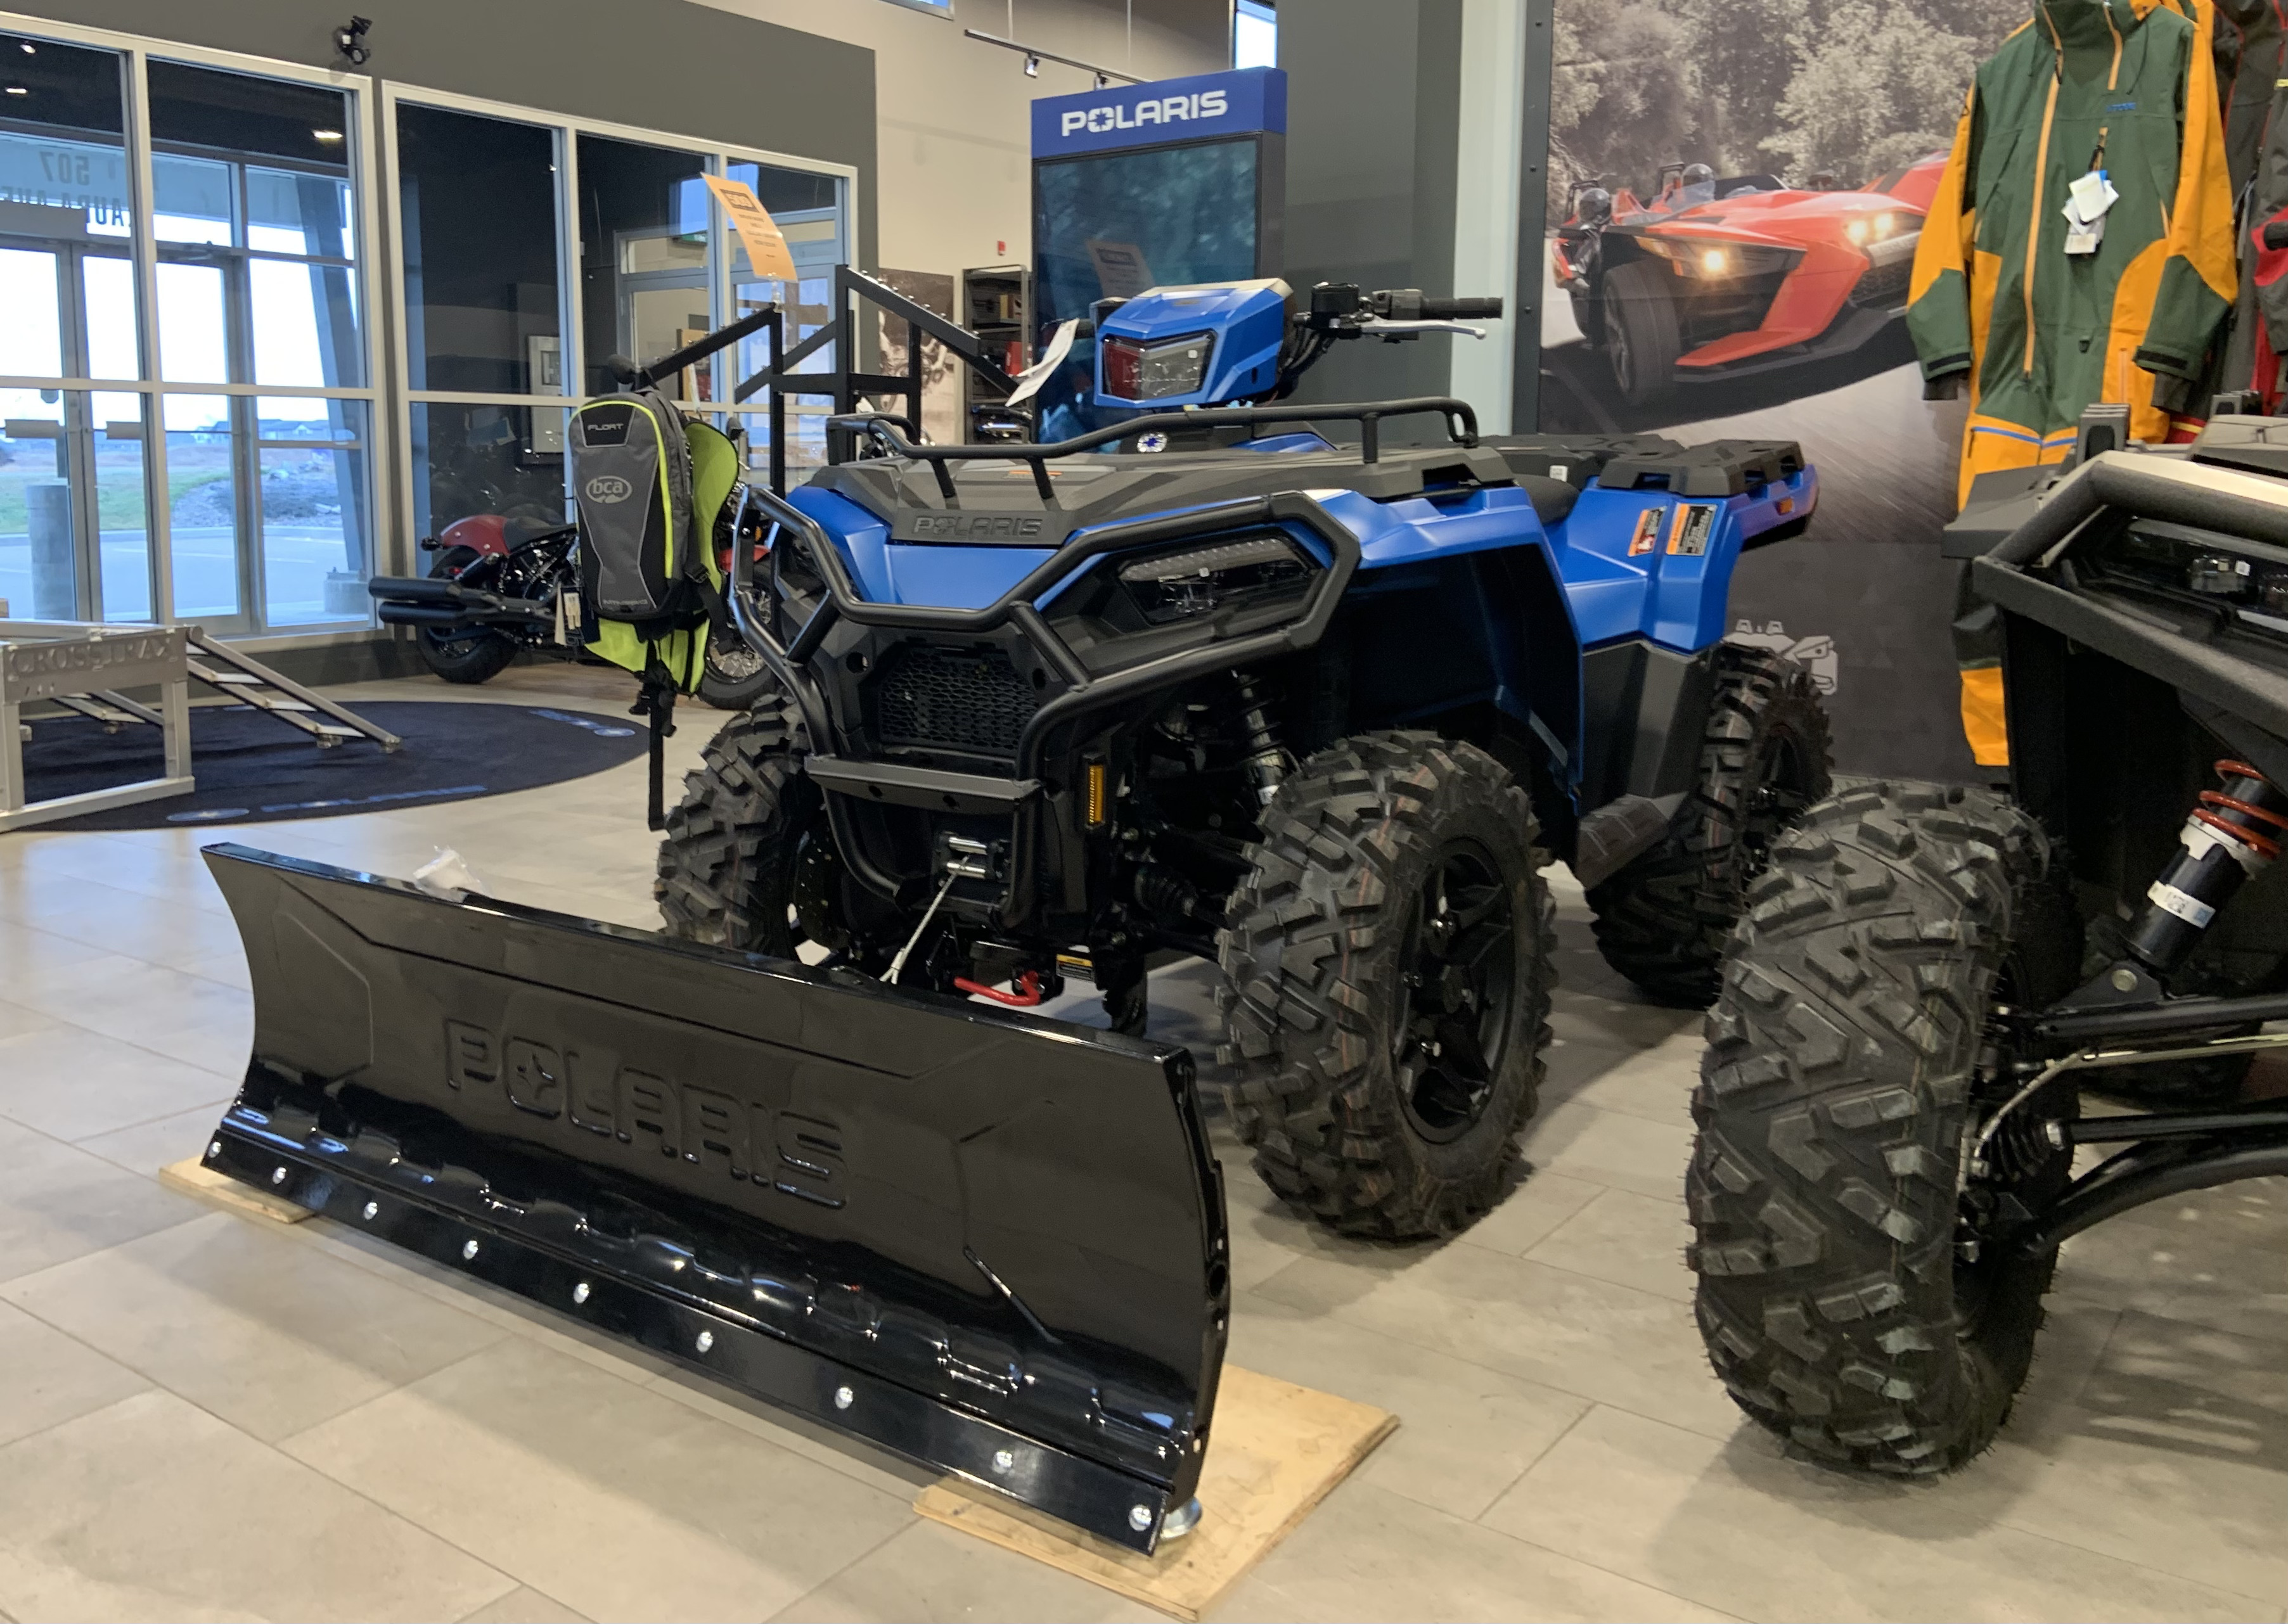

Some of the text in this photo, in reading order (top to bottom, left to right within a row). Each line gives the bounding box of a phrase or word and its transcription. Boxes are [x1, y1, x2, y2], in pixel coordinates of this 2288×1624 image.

[1062, 90, 1228, 137] POLARIS
[592, 478, 624, 494] bca
[911, 515, 1043, 537] POLARIS
[446, 1018, 847, 1208] POLARIS
